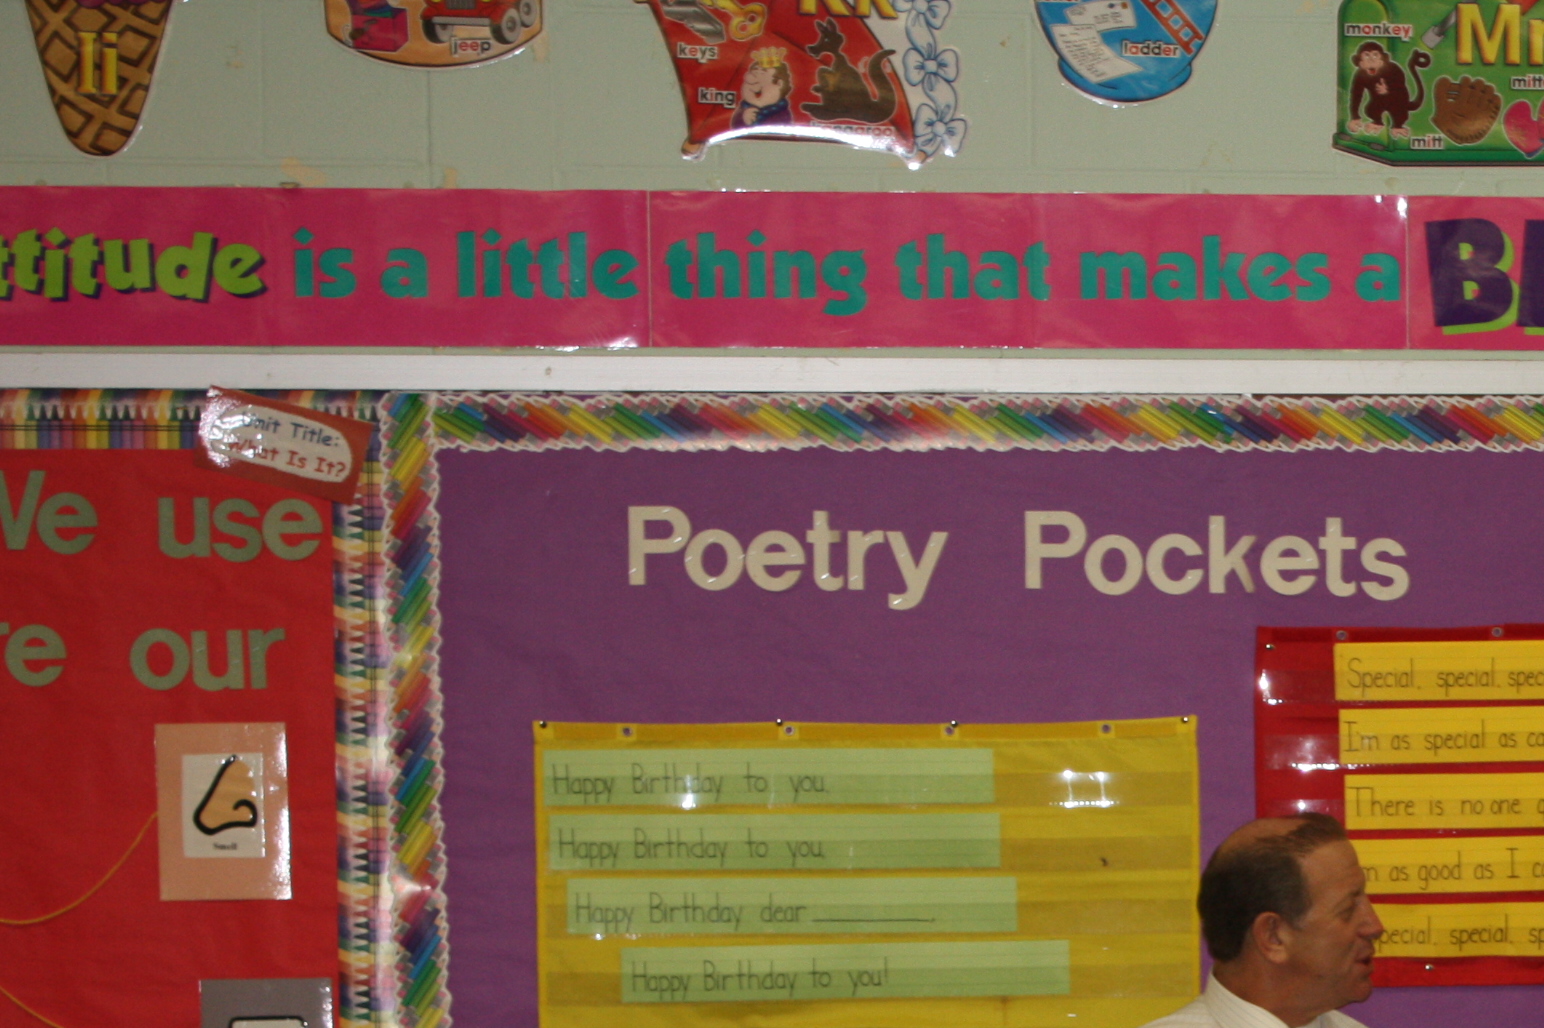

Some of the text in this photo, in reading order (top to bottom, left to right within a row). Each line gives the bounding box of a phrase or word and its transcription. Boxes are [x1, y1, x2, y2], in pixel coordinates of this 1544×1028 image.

[452, 38, 491, 54] jeep
[1124, 41, 1178, 56] ladder
[1345, 23, 1411, 40] monkey
[78, 31, 118, 94] Ii
[678, 43, 717, 60] keys
[700, 89, 736, 106] king
[1411, 135, 1442, 148] mitt
[294, 227, 356, 299] is
[381, 248, 429, 299] a
[457, 228, 640, 300] little
[665, 229, 868, 316] thing
[895, 233, 1051, 301] that
[1079, 235, 1331, 302] makes
[1355, 252, 1401, 302] a
[290, 421, 340, 446] Title:
[287, 450, 308, 469] Is
[314, 457, 346, 477] It?
[158, 497, 323, 562] use
[627, 505, 1410, 610] Poetry Pockets
[130, 628, 285, 691] our
[1343, 721, 1380, 751] I'm
[1390, 734, 1411, 751] as
[1424, 719, 1486, 757] special
[1498, 732, 1518, 748] as
[552, 762, 768, 803] Happy Birthday to
[1346, 786, 1415, 817] There
[1429, 797, 1445, 816] is
[1460, 797, 1485, 816] no
[1490, 796, 1521, 815] one
[212, 842, 238, 850] Smell
[558, 827, 769, 868] Happy Birthday to
[1389, 865, 1410, 882] as
[1417, 850, 1462, 890] good
[1474, 864, 1495, 880] as
[1505, 847, 1519, 879] I
[575, 891, 807, 933] Happy Birthday dear
[632, 956, 888, 999] Happy Birthday to you!
